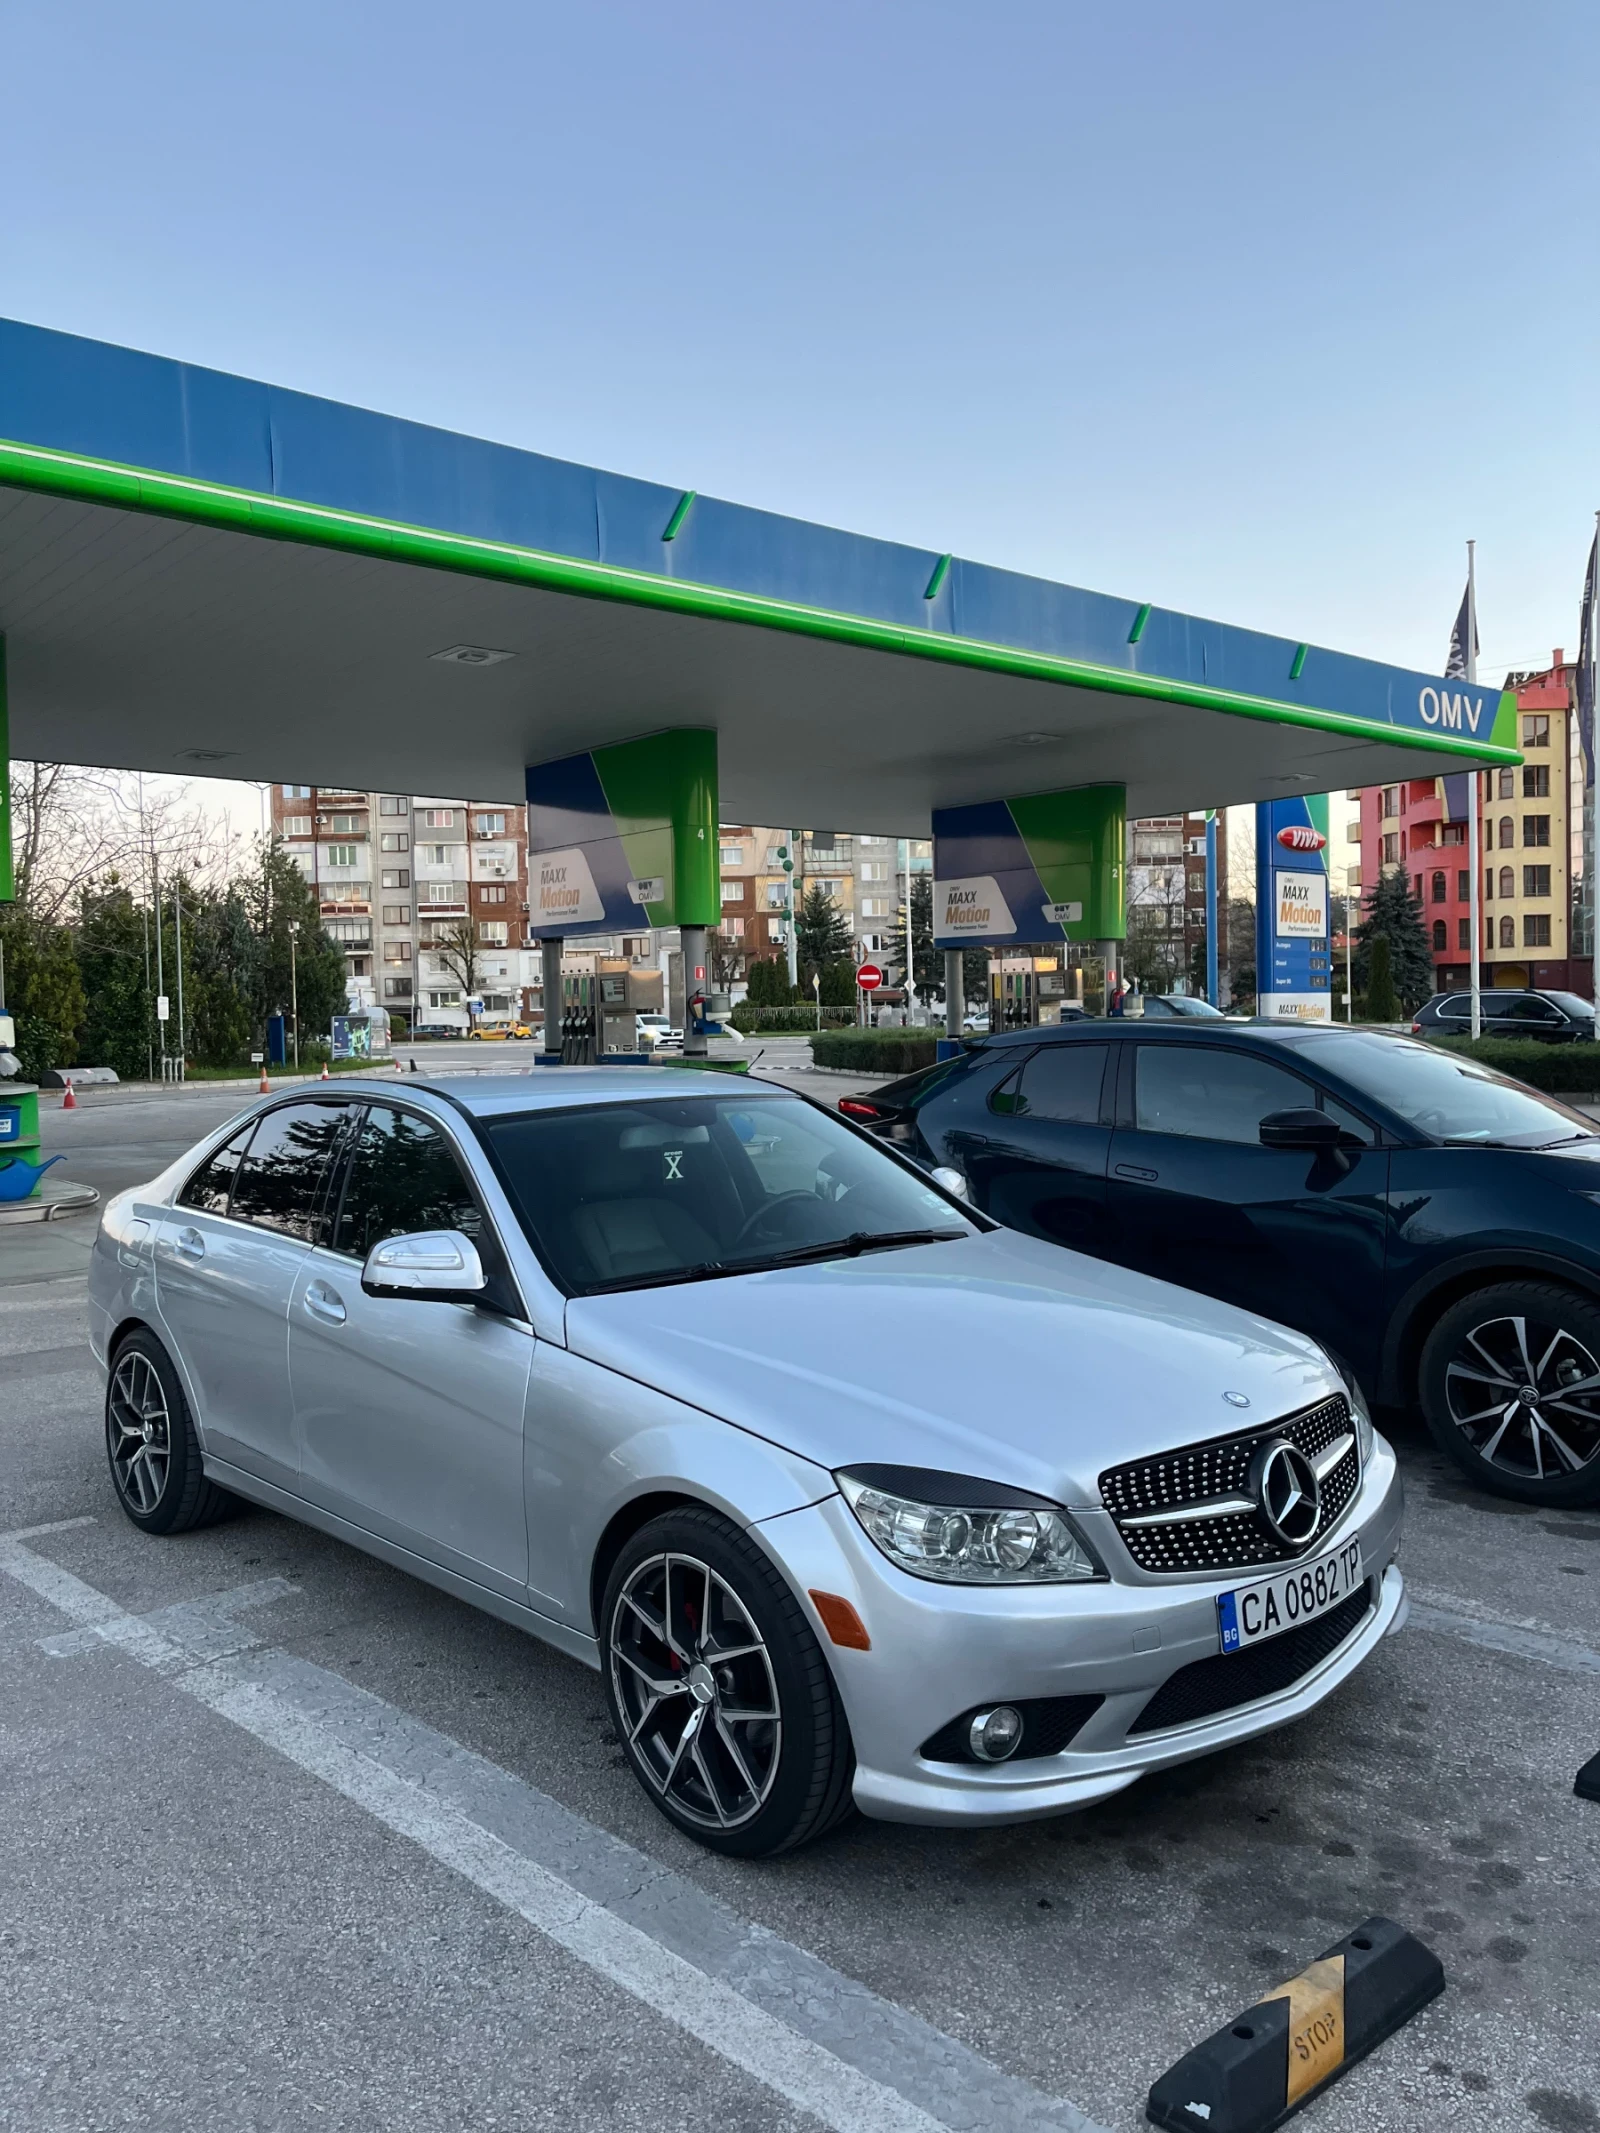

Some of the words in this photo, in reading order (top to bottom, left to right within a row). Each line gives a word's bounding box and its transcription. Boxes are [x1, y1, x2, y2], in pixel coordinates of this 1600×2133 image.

[1419, 687, 1482, 732] OMV
[697, 828, 705, 840] 4
[1292, 830, 1319, 848] VIVA
[540, 867, 567, 885] MAXX
[1111, 868, 1118, 878] 2
[539, 886, 580, 909] Motion
[638, 892, 654, 901] OMV
[948, 891, 977, 905] MAXX
[1282, 885, 1309, 900] MAXX
[945, 905, 990, 924] Motion
[1054, 913, 1070, 921] OMV
[1280, 901, 1321, 924] Motion
[664, 1155, 684, 1179] X
[1242, 1587, 1281, 1636] CA
[1285, 1559, 1339, 1620] 0882
[1340, 1542, 1359, 1590] TP
[1223, 1628, 1237, 1643] BG
[1295, 2013, 1335, 2060] STOP
